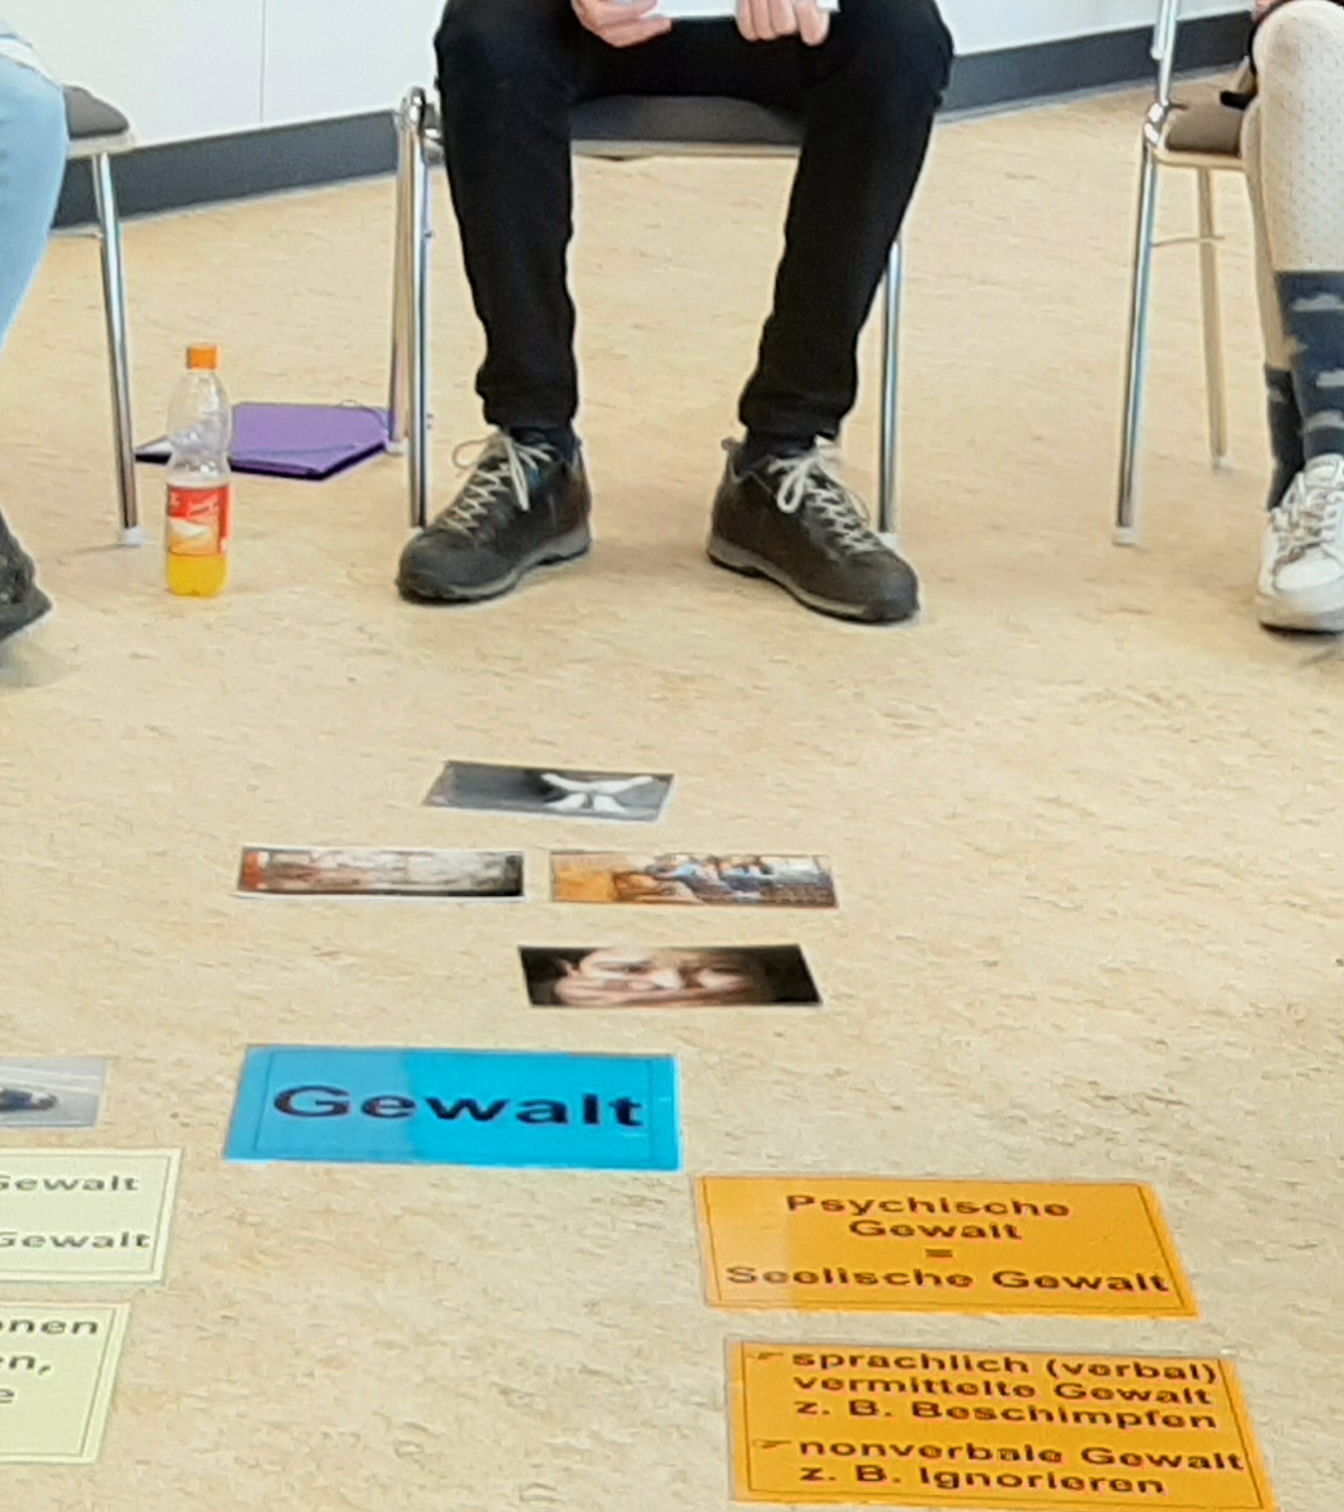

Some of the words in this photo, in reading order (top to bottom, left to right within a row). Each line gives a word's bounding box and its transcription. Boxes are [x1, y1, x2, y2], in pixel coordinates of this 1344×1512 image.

[273, 1085, 645, 1127] Gewalt
[786, 1194, 1071, 1218] Psychische
[848, 1220, 1024, 1241] Gewalt
[725, 1265, 974, 1288] Seelische
[991, 1269, 1170, 1293] Gewalt
[792, 1350, 1030, 1376] sprachlich
[1045, 1357, 1218, 1385] (verbal)
[793, 1375, 1037, 1399] vermittelte
[1053, 1381, 1213, 1406] Gewalt
[794, 1400, 831, 1416] z.
[848, 1399, 894, 1418] B.
[912, 1401, 1218, 1431] Beschimpfen
[798, 1439, 1063, 1465] nonverbale
[1080, 1447, 1245, 1472] Gewalt
[799, 1467, 836, 1483] z.
[854, 1464, 902, 1484] B.
[920, 1466, 1165, 1494] Ignorieren
